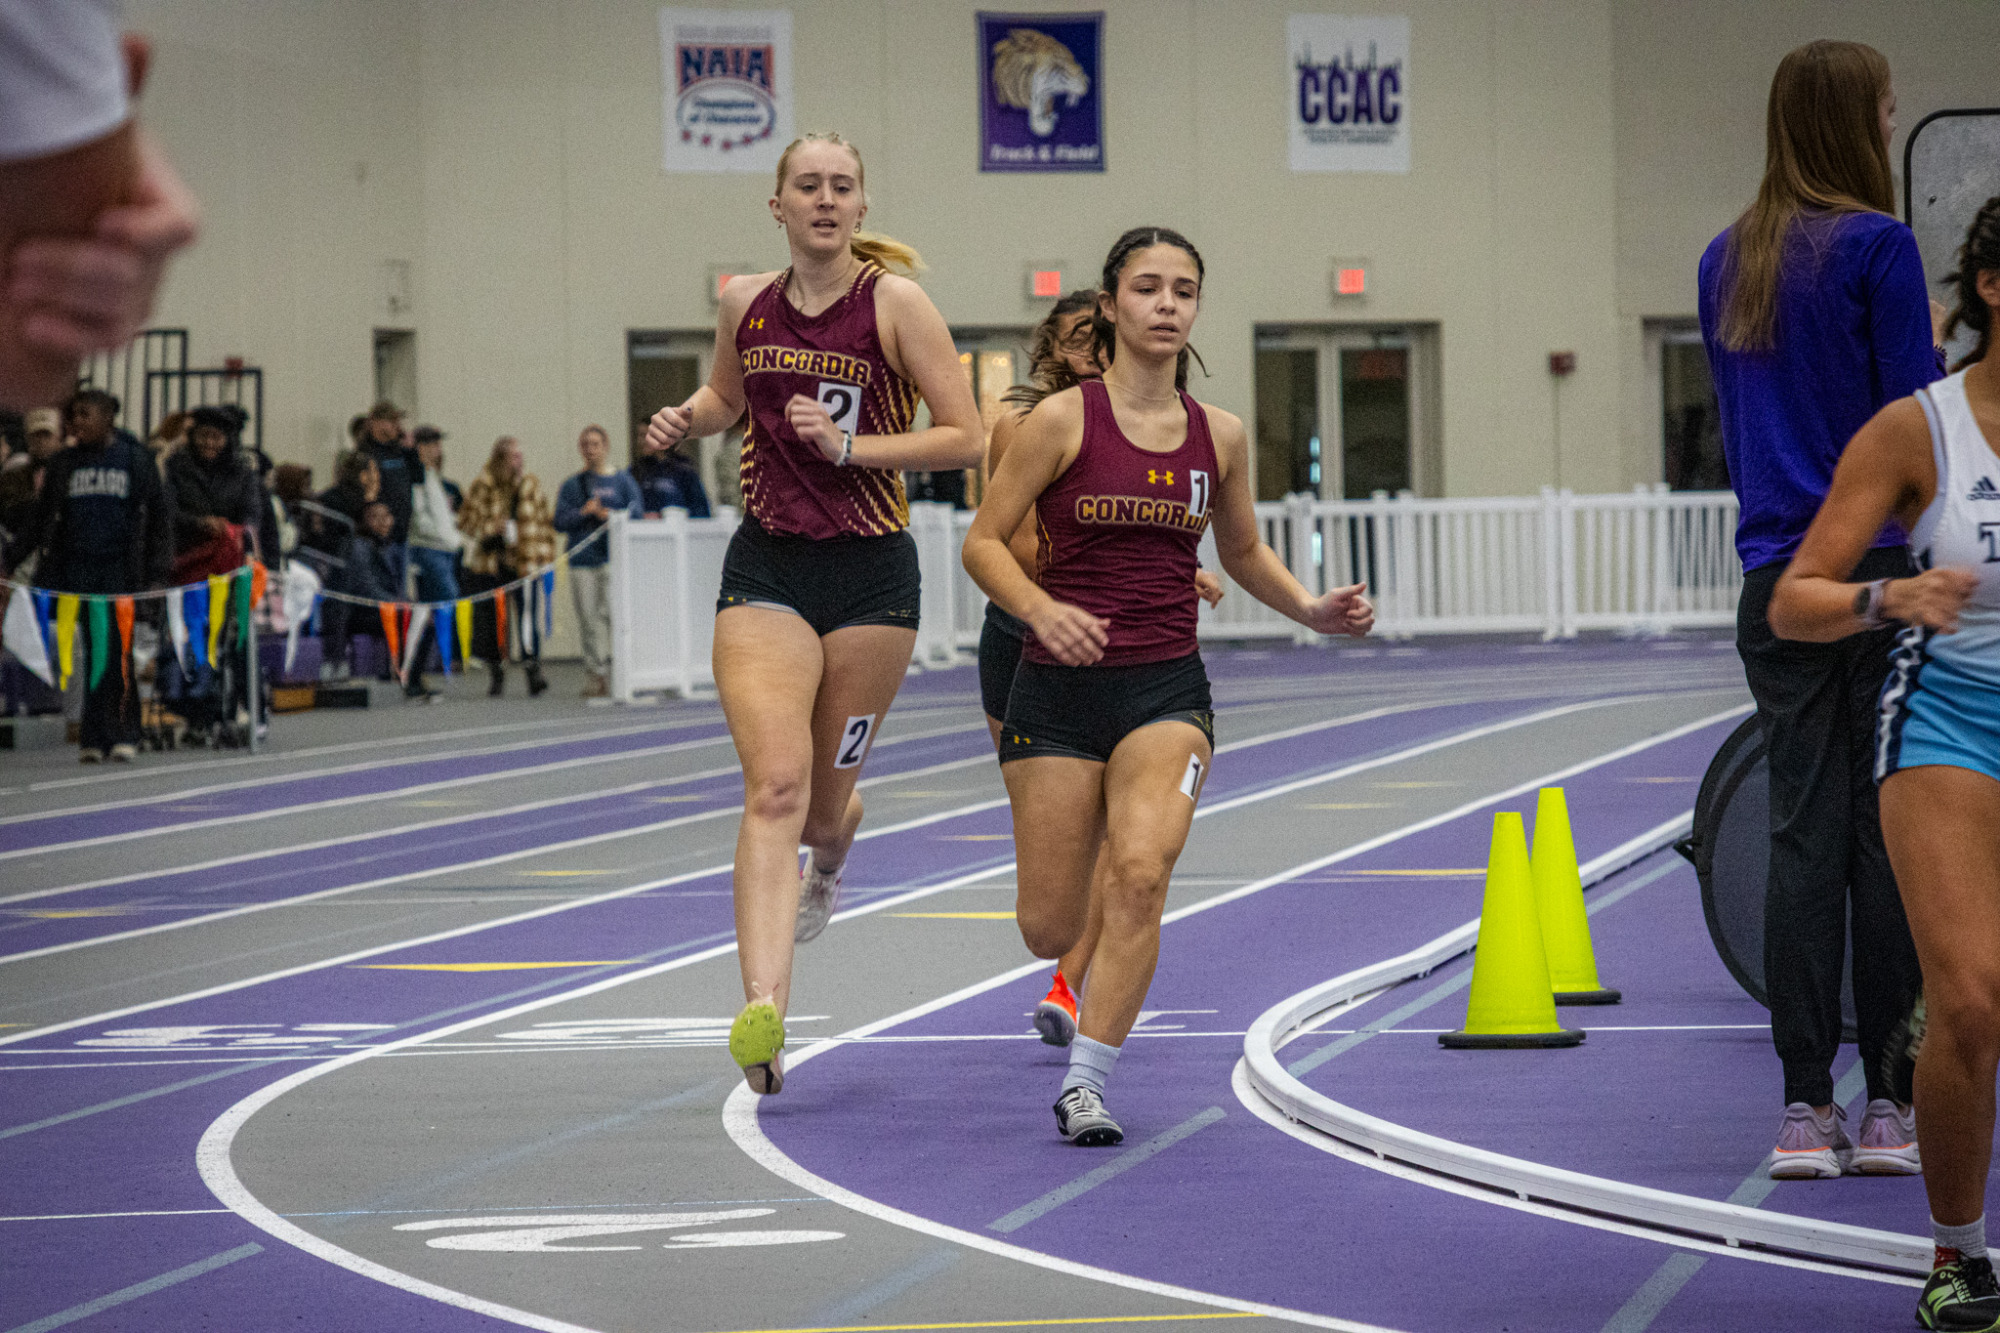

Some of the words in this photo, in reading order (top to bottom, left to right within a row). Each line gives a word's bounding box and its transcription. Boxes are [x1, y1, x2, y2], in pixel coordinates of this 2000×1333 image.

[682, 48, 769, 87] NAIA
[1299, 66, 1400, 124] CCAC
[990, 143, 1034, 162] Track
[1037, 143, 1051, 162] &
[1054, 143, 1100, 162] Field
[741, 346, 871, 388] CONCORDIA
[822, 388, 853, 434] 2
[1194, 473, 1206, 514] 1
[840, 719, 868, 765] 2
[1191, 762, 1200, 797] 1
